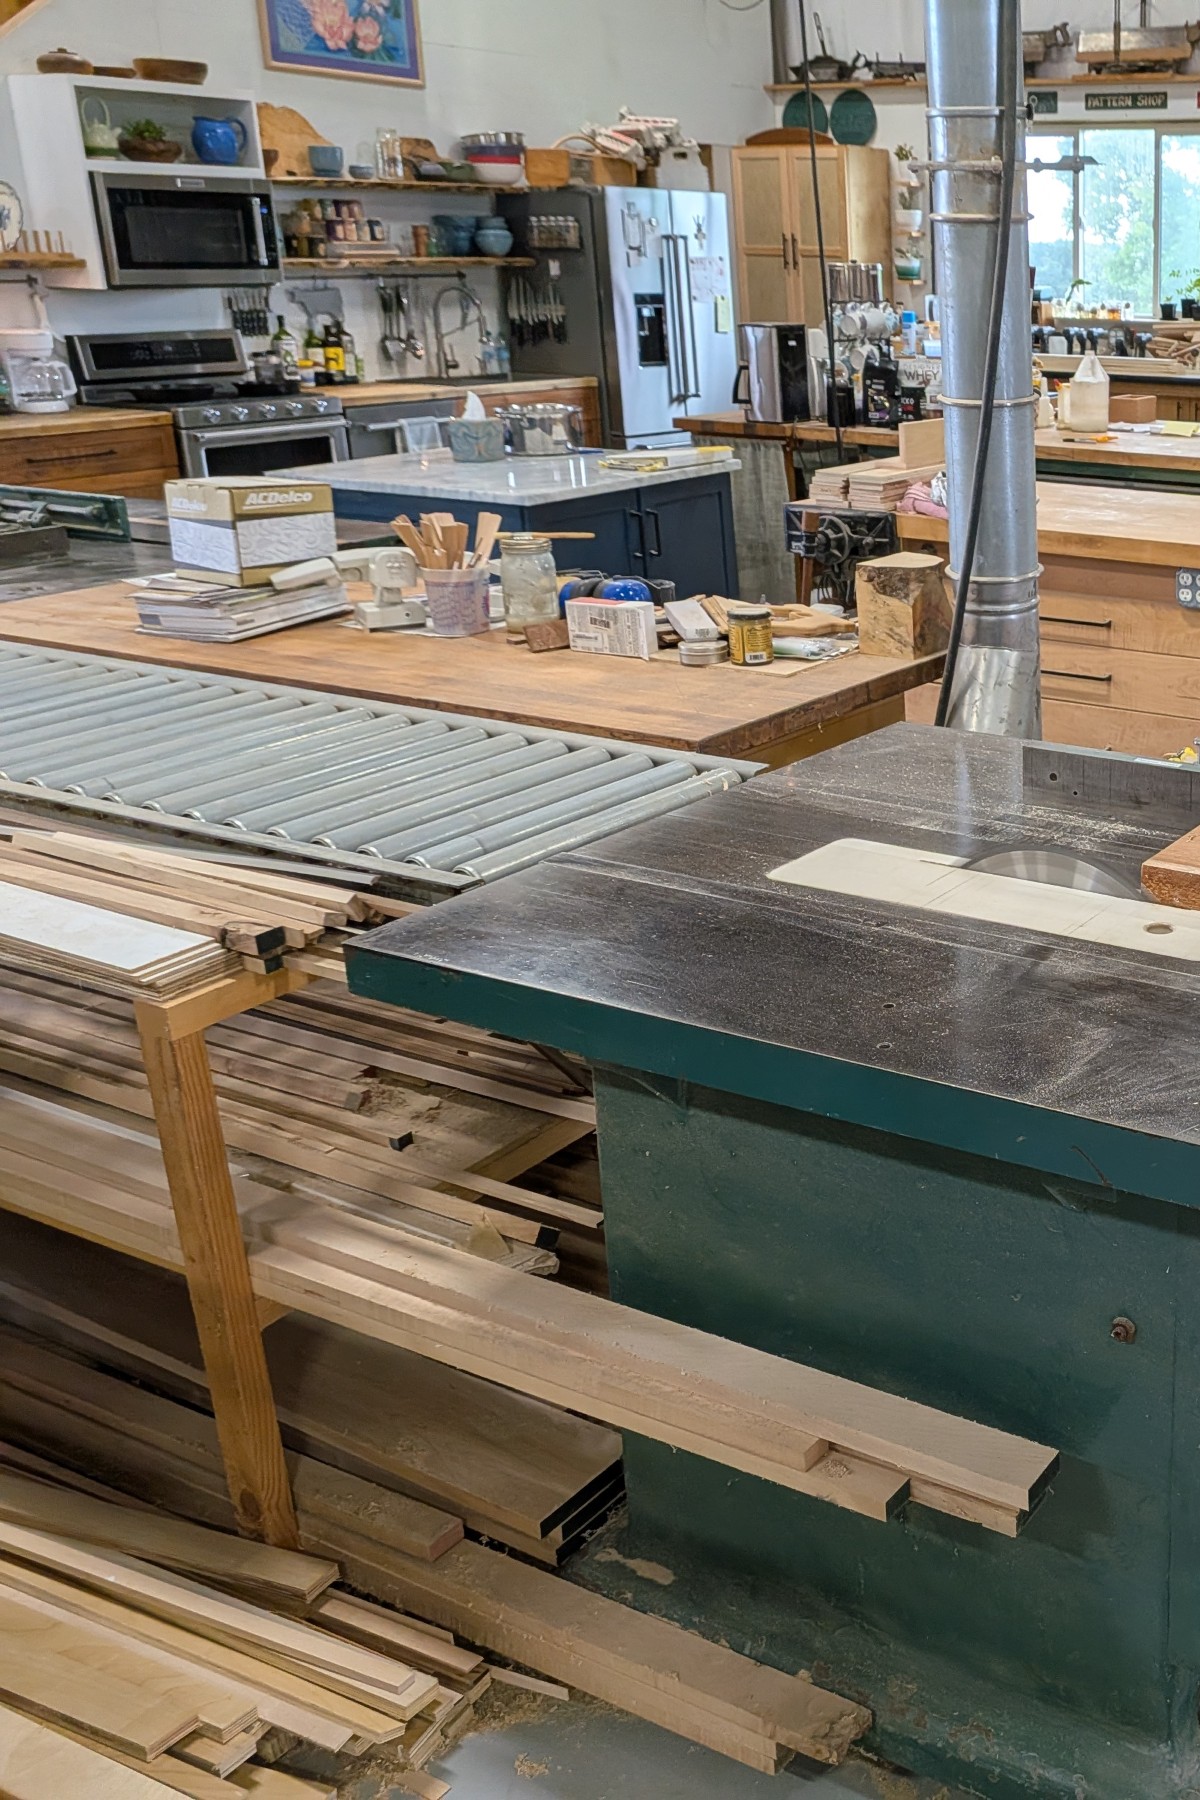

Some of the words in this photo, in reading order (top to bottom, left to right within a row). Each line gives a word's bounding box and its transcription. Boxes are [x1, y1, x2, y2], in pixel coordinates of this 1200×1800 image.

[1087, 96, 1133, 108] PATTERN
[1137, 95, 1166, 107] SHOP
[904, 370, 939, 381] WHEY
[245, 491, 313, 505] ACDelco
